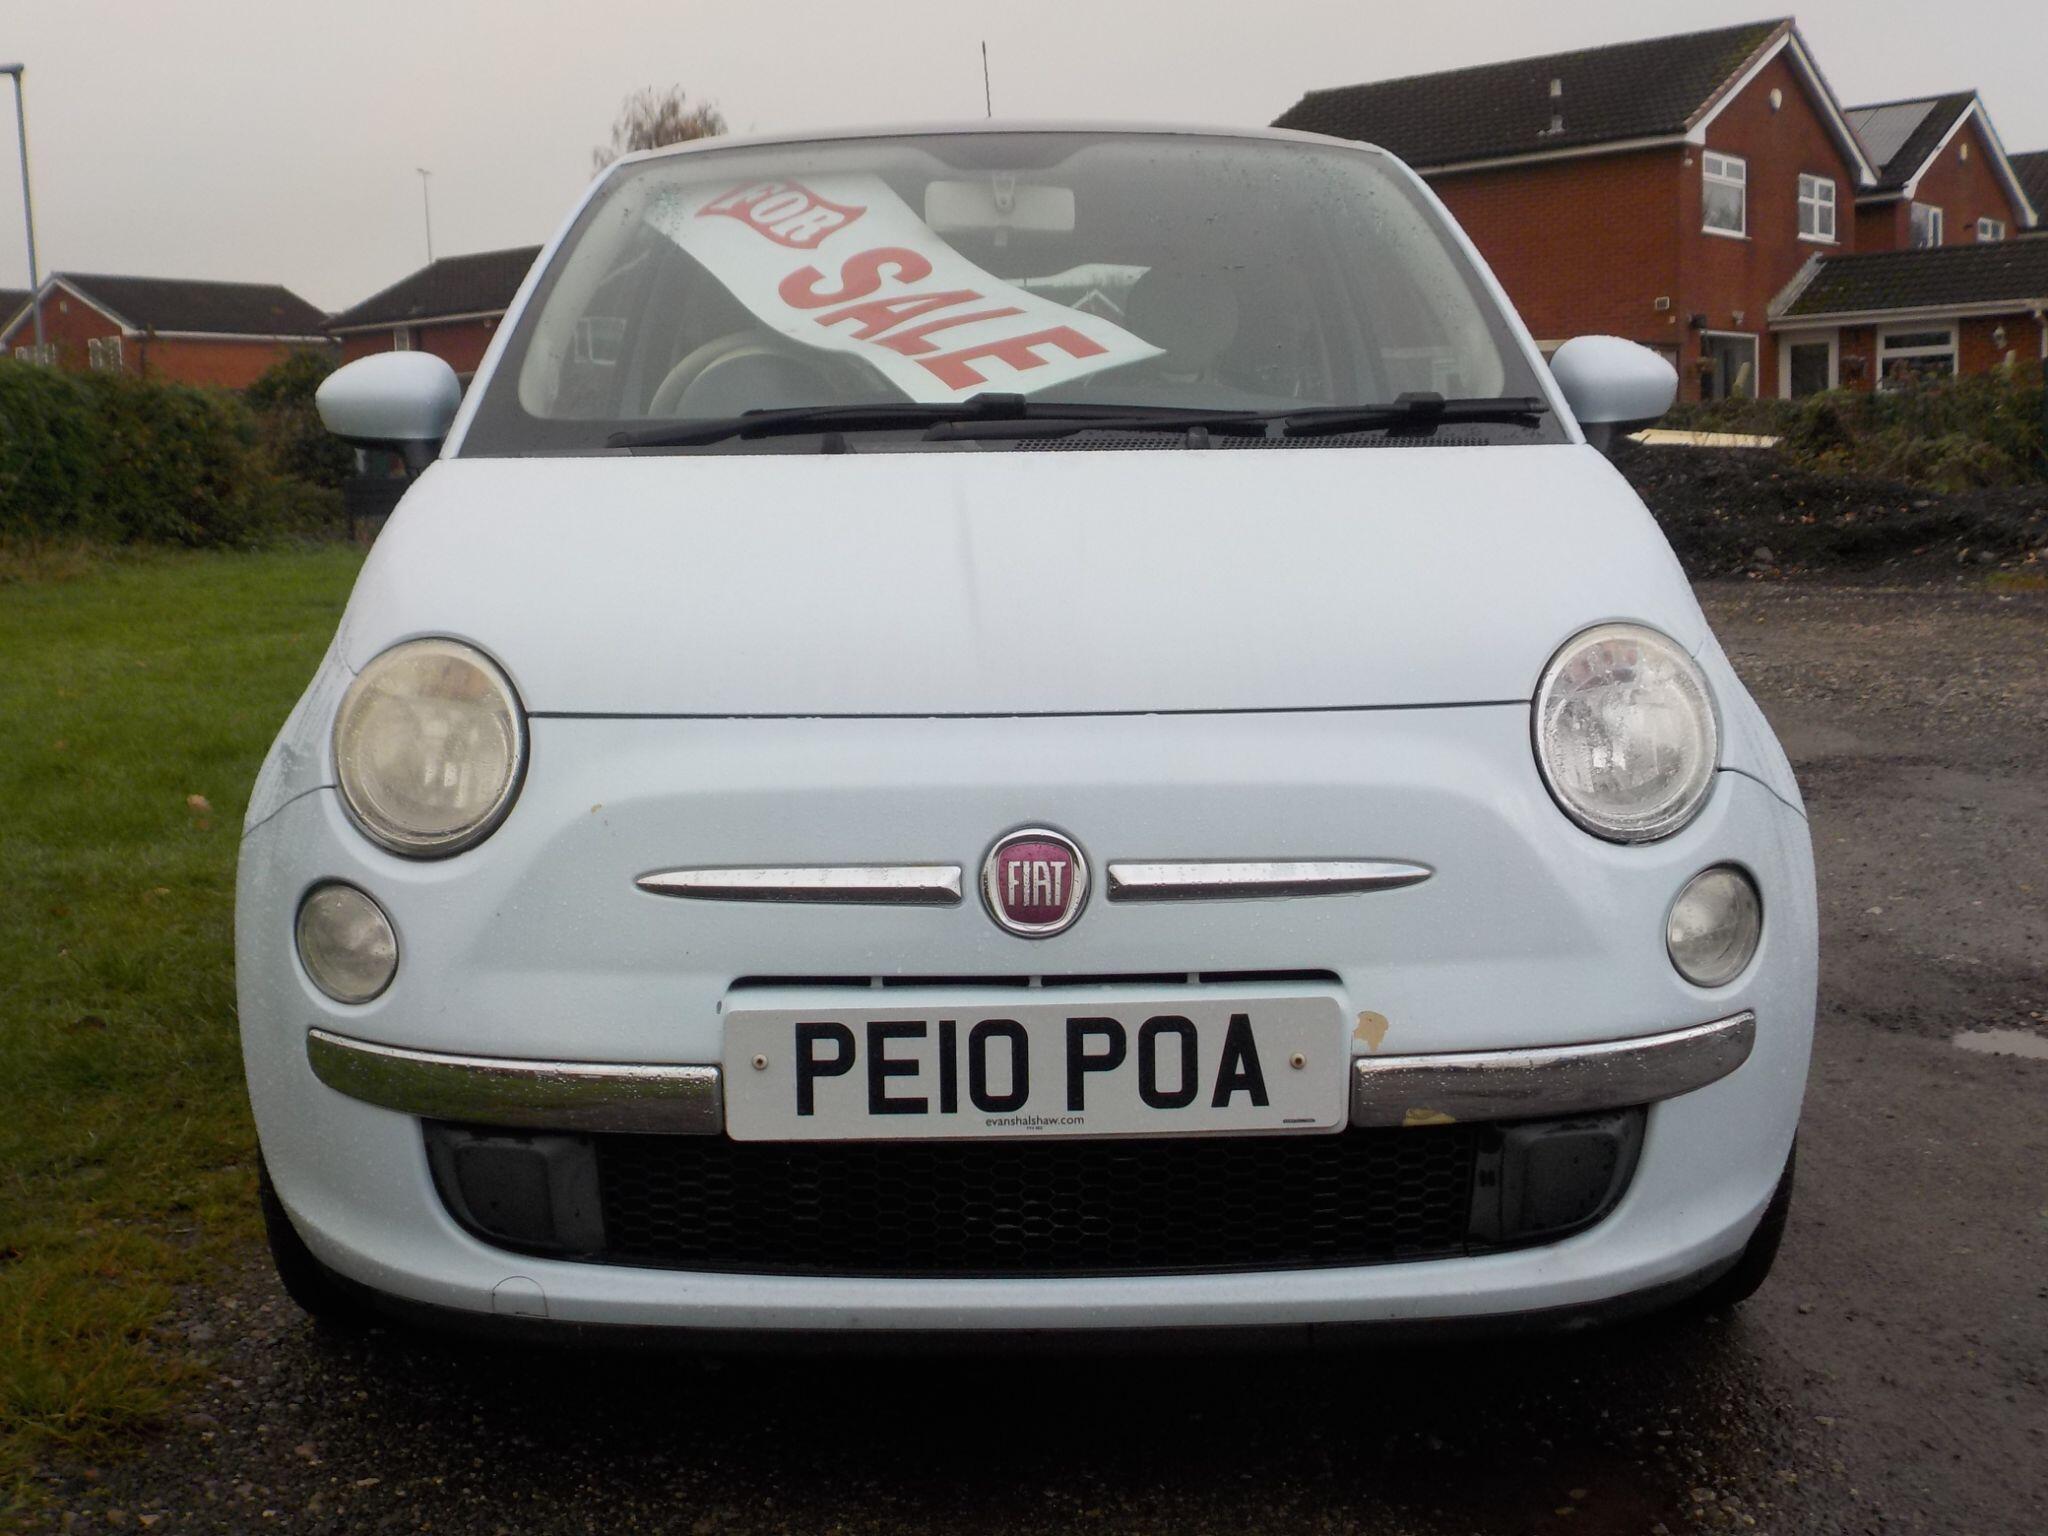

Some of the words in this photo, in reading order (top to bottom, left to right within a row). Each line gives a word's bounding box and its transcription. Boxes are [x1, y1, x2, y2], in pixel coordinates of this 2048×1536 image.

[708, 180, 847, 242] FOR
[777, 246, 1110, 391] SALE
[1007, 860, 1067, 907] FIAT
[794, 1018, 1030, 1117] PE10
[1065, 1013, 1270, 1112] POA
[985, 1115, 1085, 1127] evanshalshaw.com
